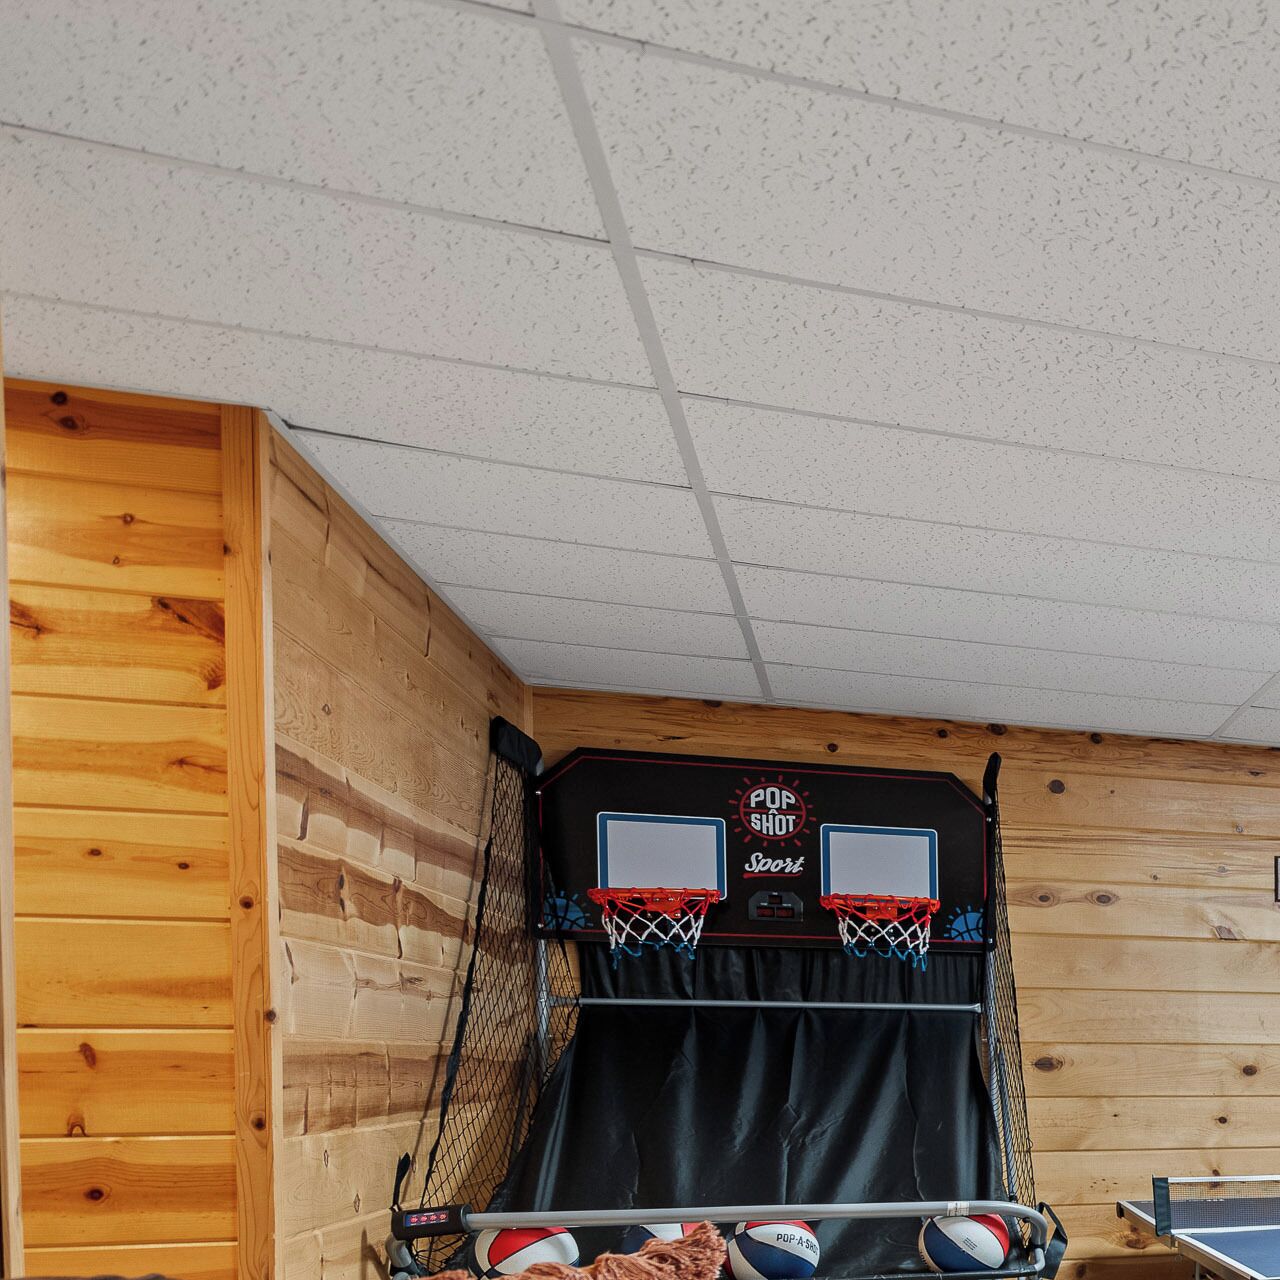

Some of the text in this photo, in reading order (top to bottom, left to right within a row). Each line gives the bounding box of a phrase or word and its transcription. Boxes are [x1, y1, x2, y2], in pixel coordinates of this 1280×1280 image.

[750, 787, 796, 810] POP
[751, 813, 796, 836] SHOT
[744, 852, 805, 873] Sport
